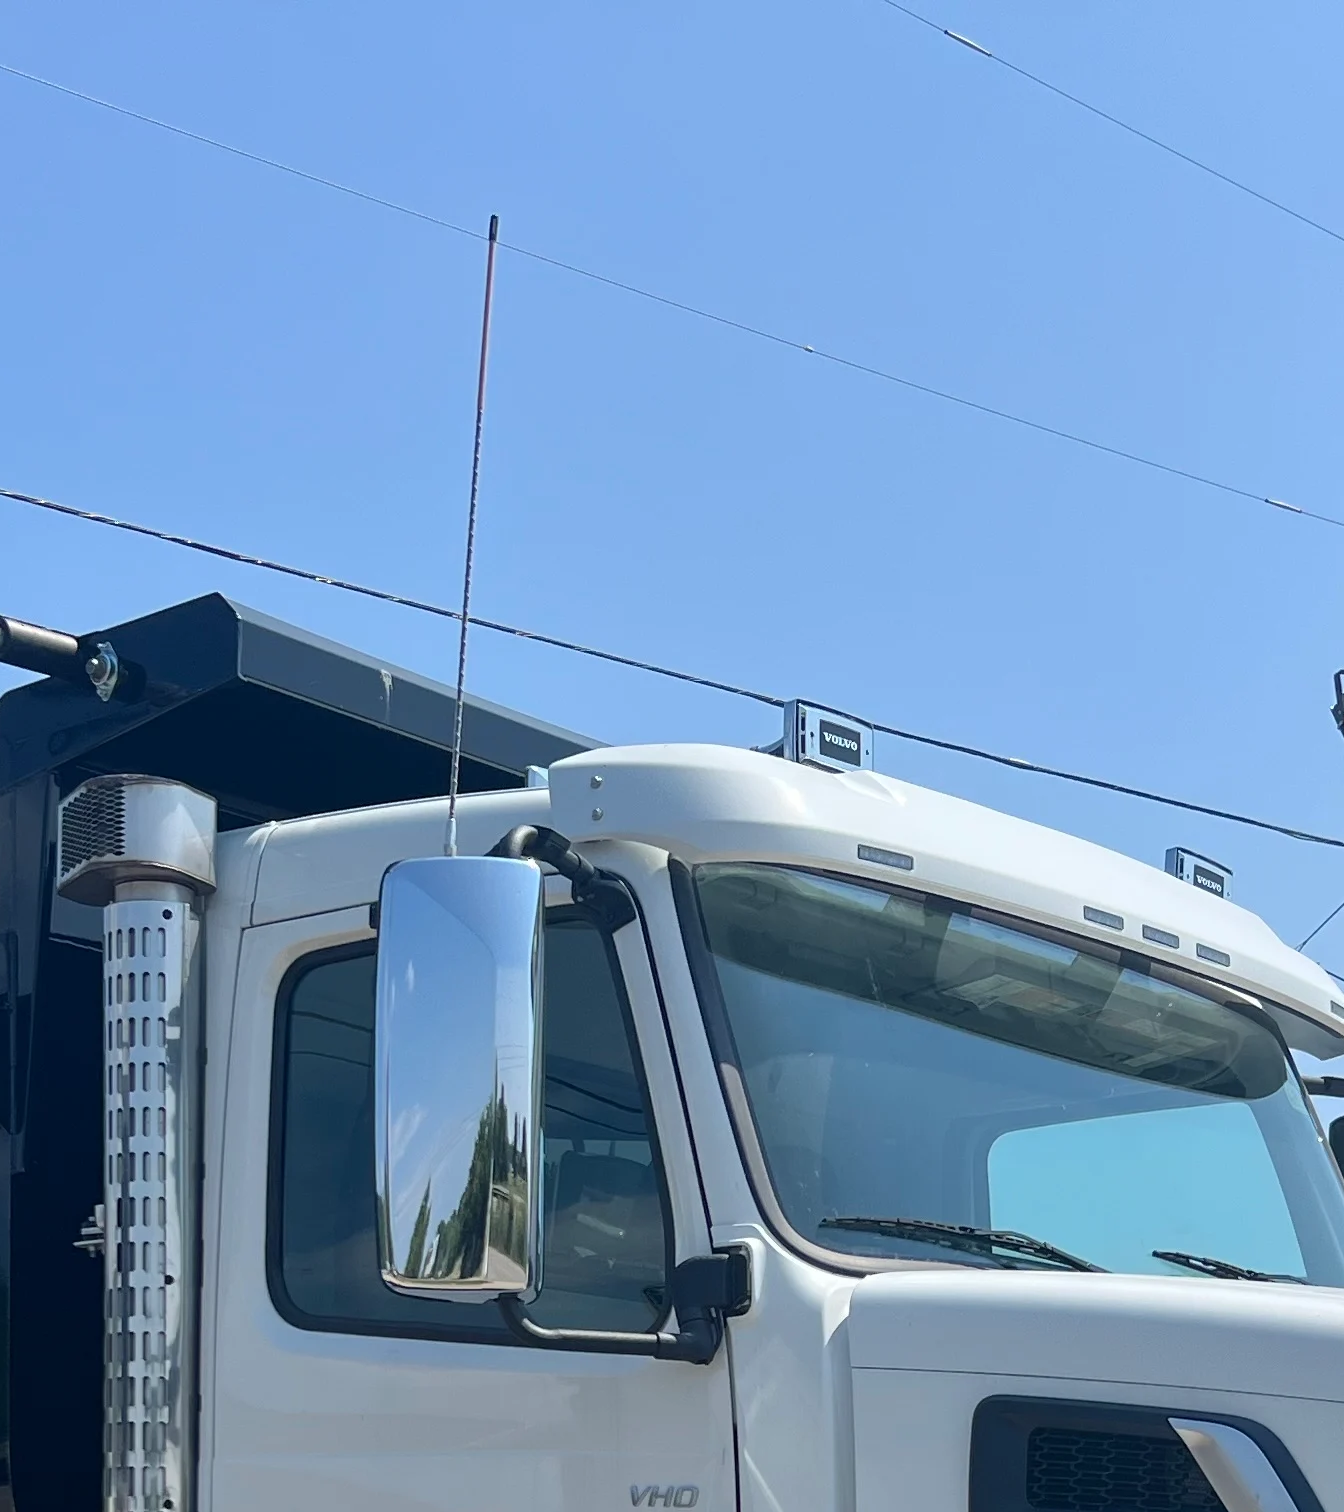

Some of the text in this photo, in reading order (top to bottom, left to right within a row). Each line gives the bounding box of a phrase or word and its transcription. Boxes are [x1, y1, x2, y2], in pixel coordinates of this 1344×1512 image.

[822, 731, 858, 752] VOLVO
[1196, 874, 1222, 893] VOLVO
[630, 1485, 700, 1508] VHD
